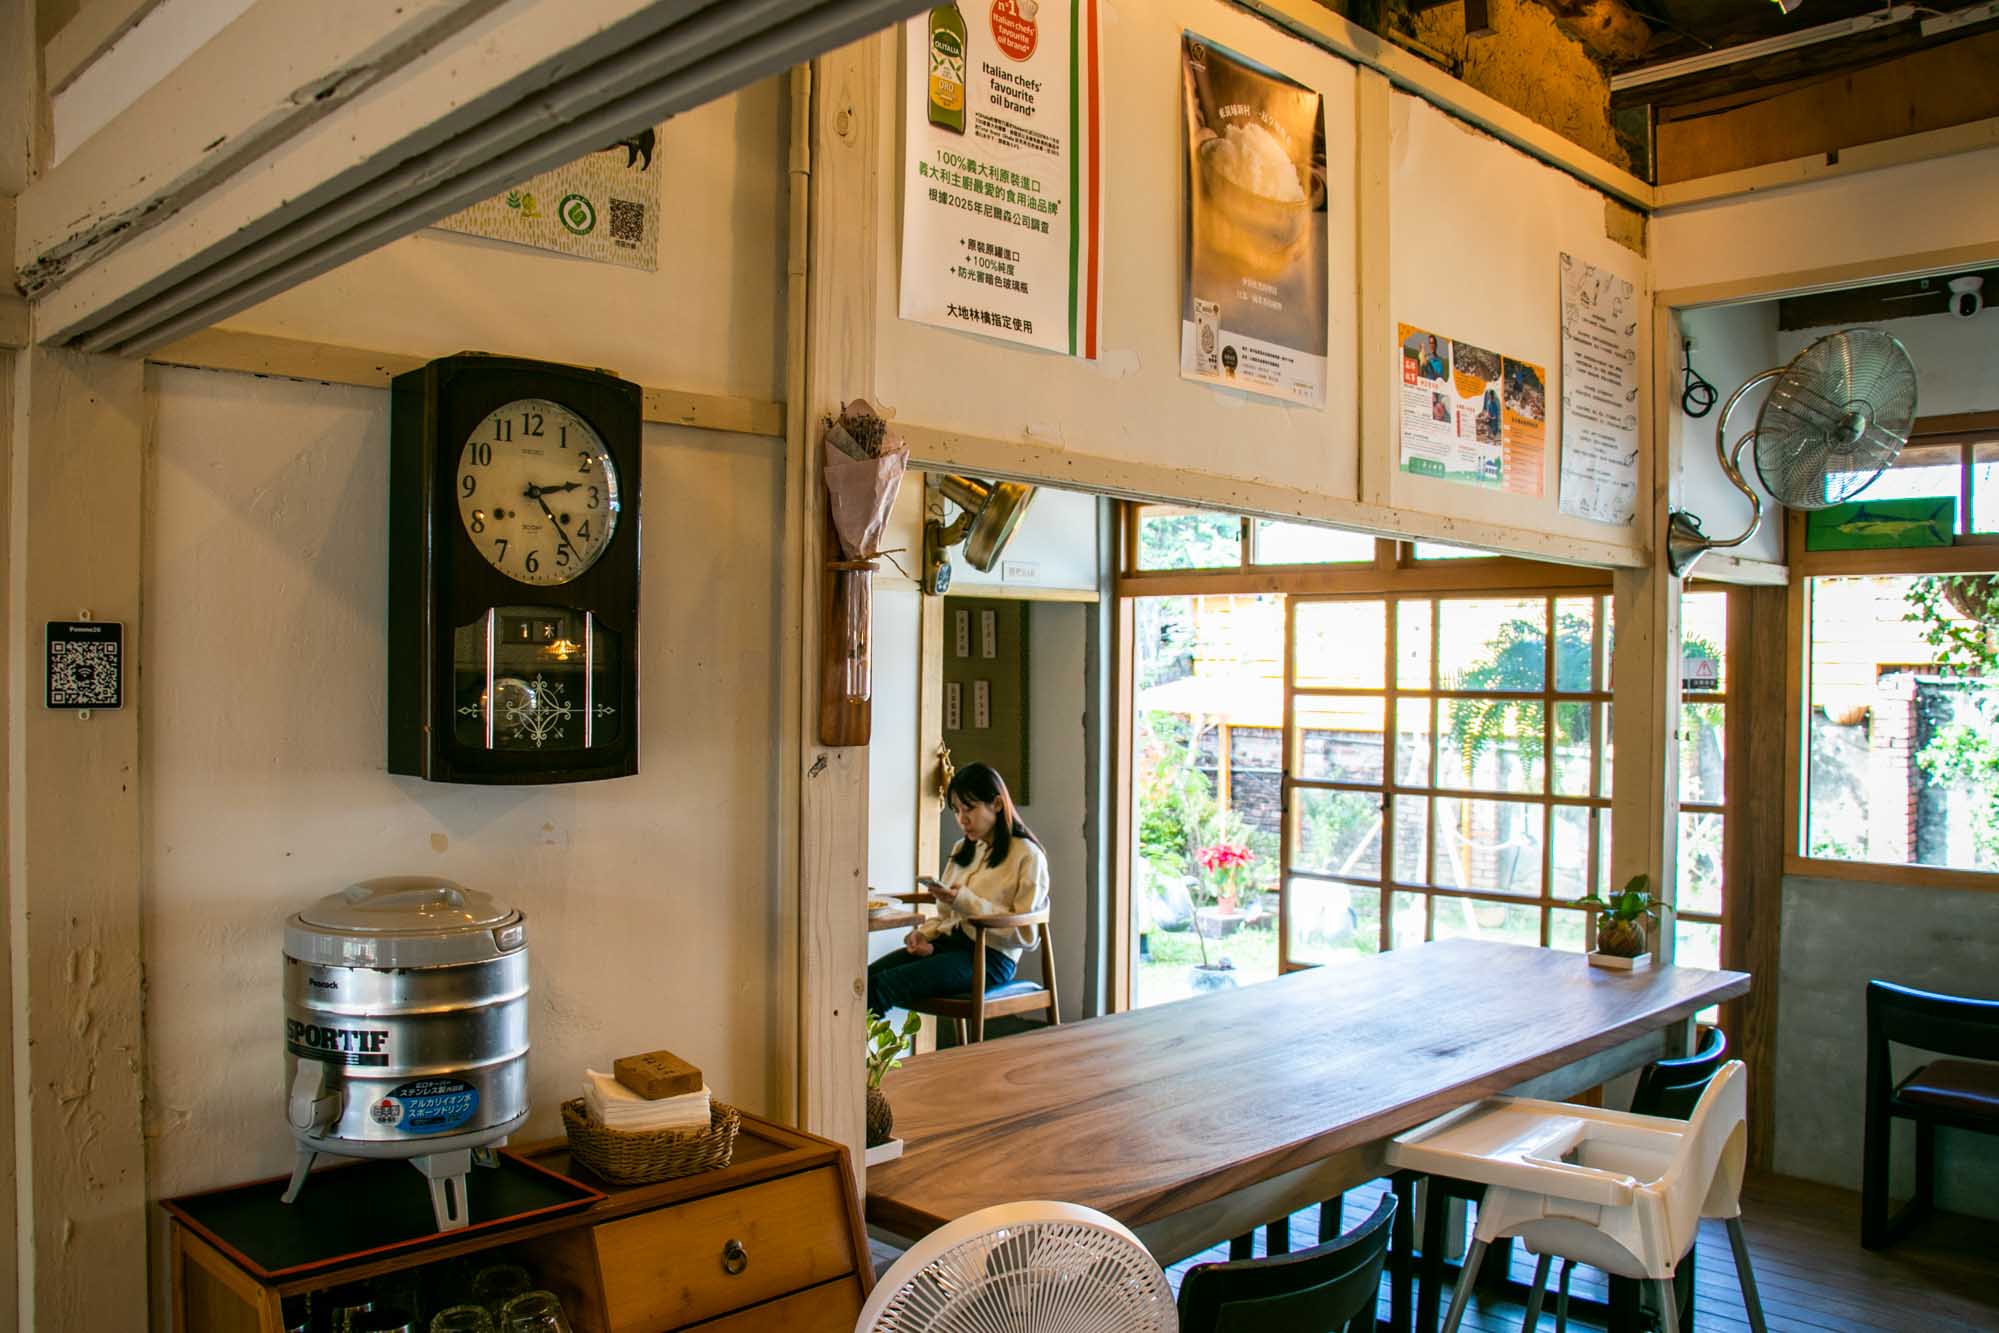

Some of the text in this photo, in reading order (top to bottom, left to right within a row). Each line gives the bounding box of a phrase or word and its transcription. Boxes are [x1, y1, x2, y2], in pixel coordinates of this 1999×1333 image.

[982, 62, 1013, 82] Italian
[990, 78, 1034, 104] favourite
[990, 94, 1002, 107] oil
[936, 150, 1041, 193] 100%義大利原裝進口
[494, 418, 512, 442] 11
[521, 413, 544, 437] 12
[560, 426, 567, 448] 1
[469, 442, 492, 466] 10
[578, 451, 591, 473] 2
[462, 475, 476, 499] 9
[587, 486, 599, 509] 3
[471, 510, 485, 533] 8
[577, 519, 590, 542] 4
[495, 539, 508, 562] 7
[525, 550, 539, 573] 6
[556, 543, 569, 566] 5
[287, 1018, 389, 1052] SPORTIF
